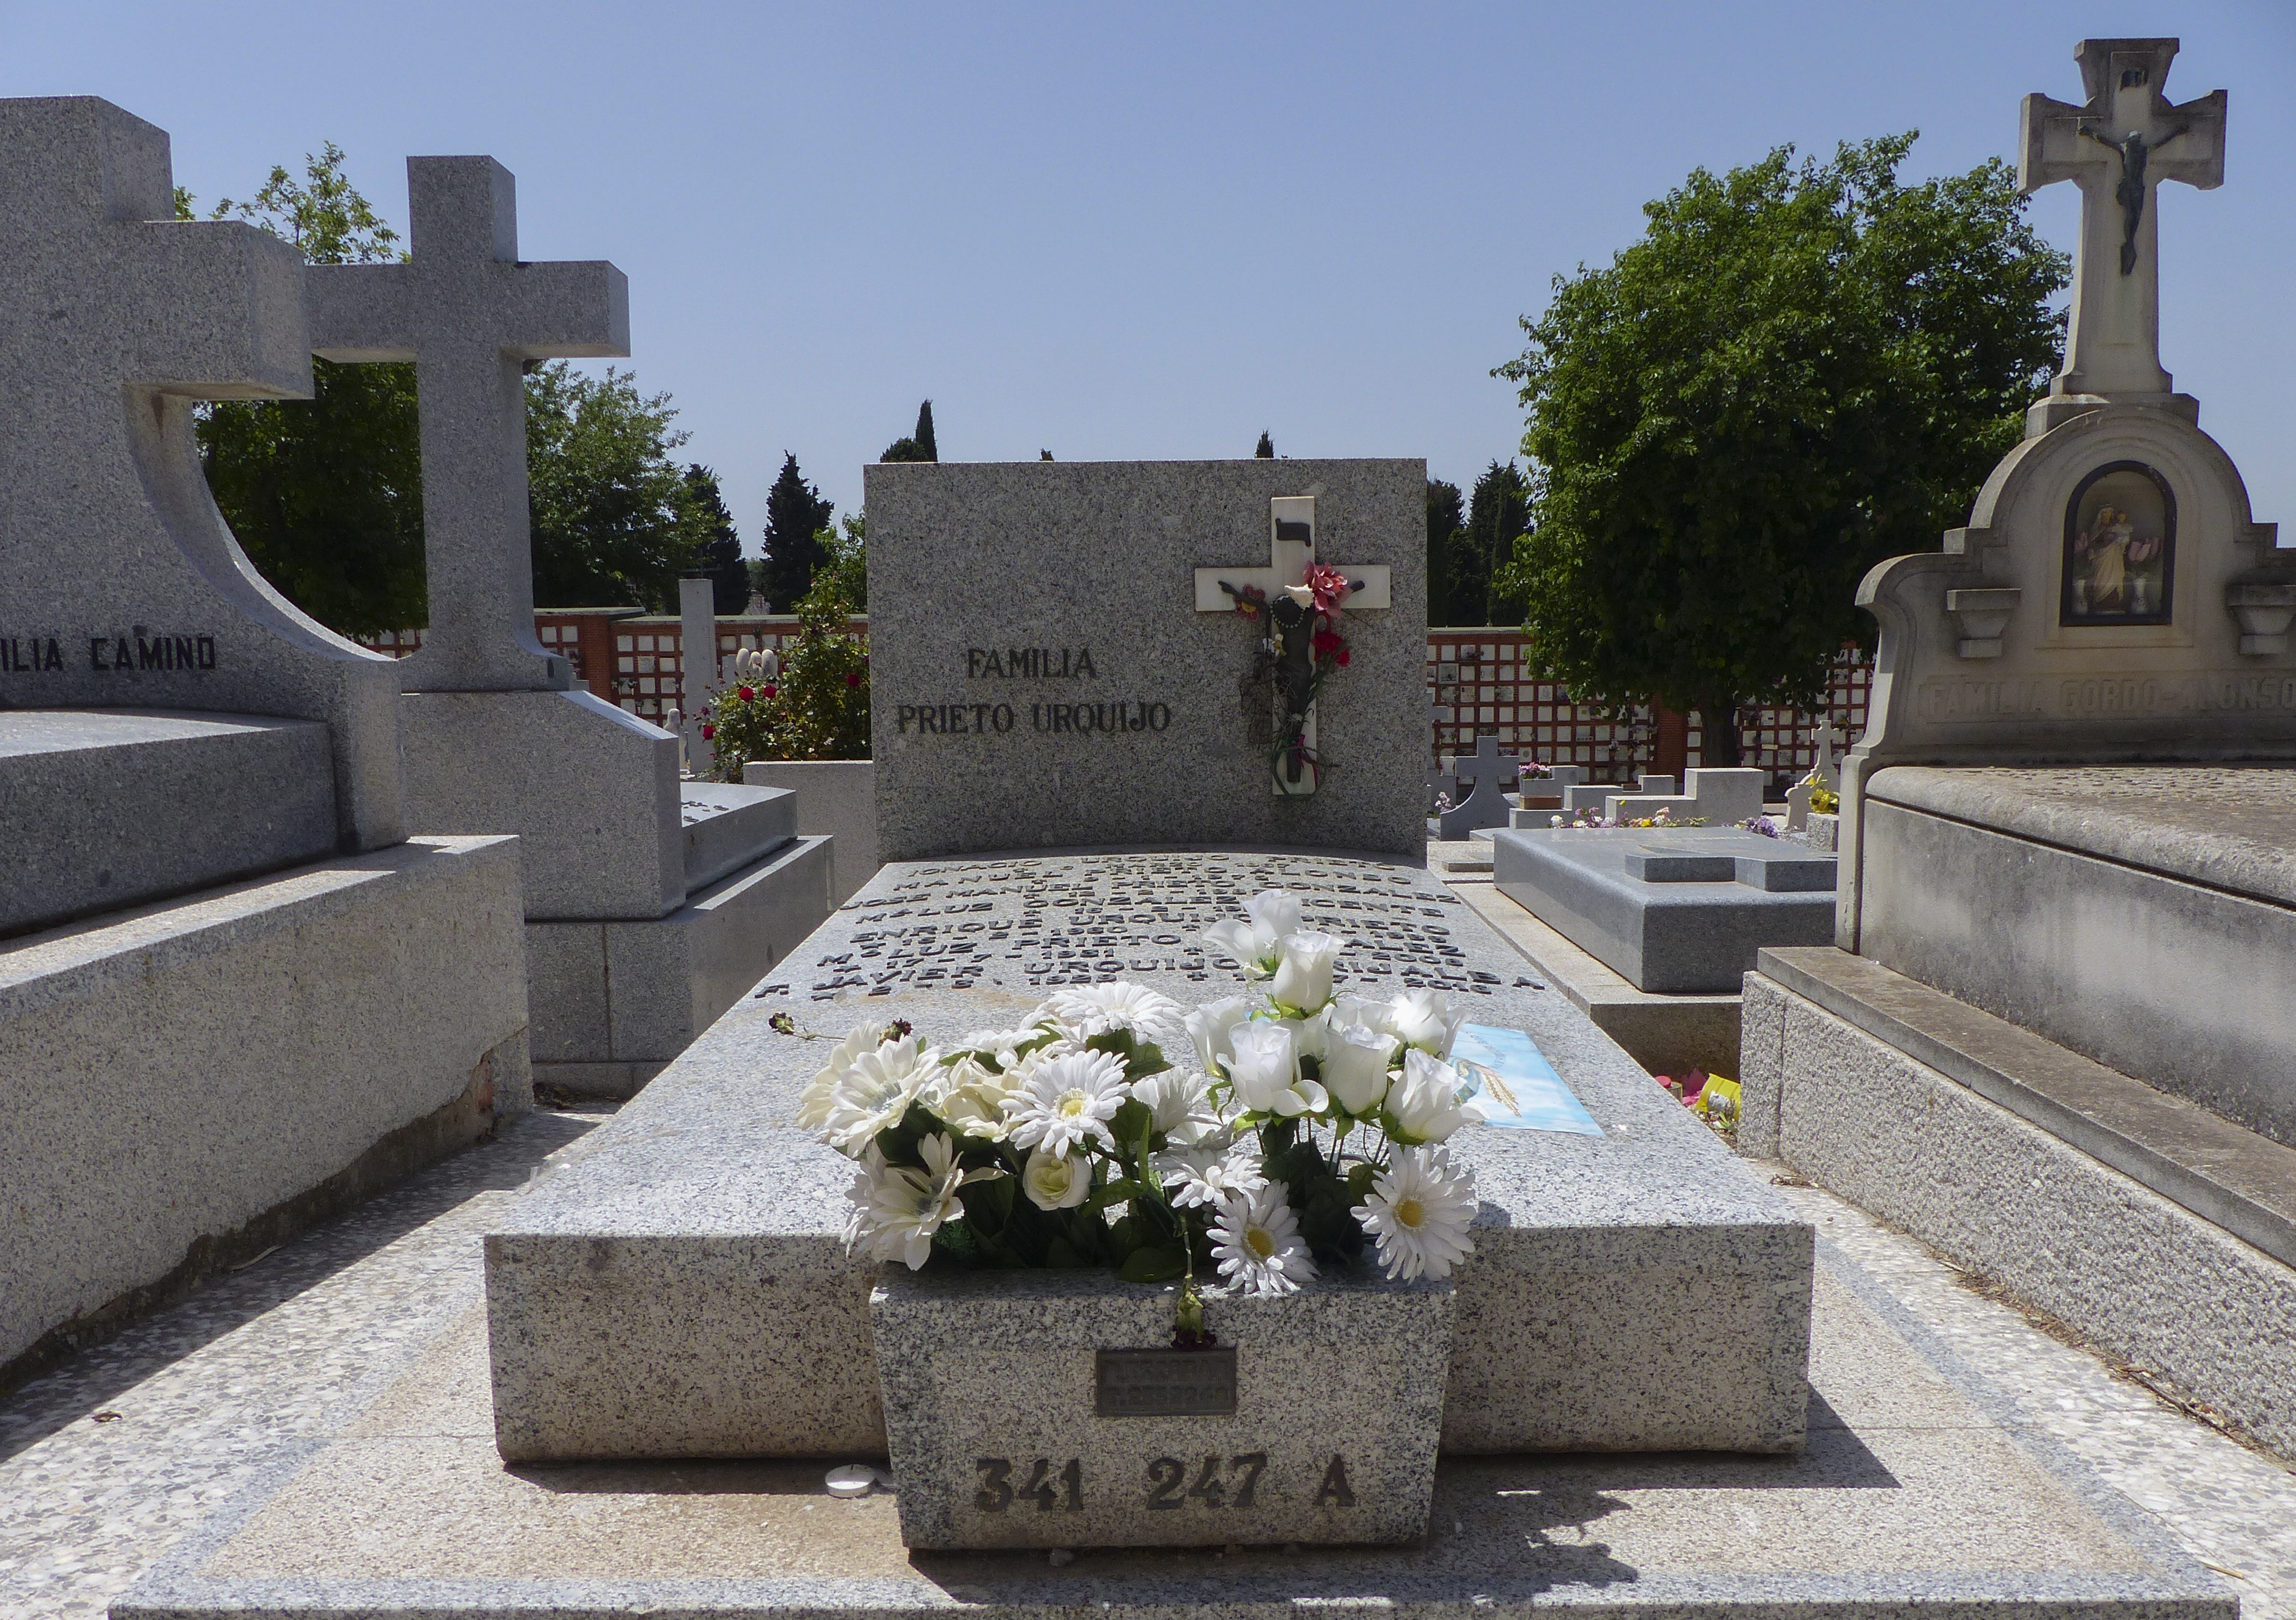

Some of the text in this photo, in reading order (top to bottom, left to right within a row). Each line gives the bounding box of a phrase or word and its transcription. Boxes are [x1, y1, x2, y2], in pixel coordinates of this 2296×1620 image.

[91, 636, 216, 671] CAMINO
[967, 648, 1096, 678] FAMILIA
[897, 702, 1171, 735] PRIETO URQUIJO
[893, 867, 1411, 891] MANUEL PRIETO ALONSO
[908, 855, 1395, 877] IGNACIO URQUIJO PRIETO
[839, 880, 1461, 910] JOSE MANUEL PRIETO GONZALEZ
[917, 902, 993, 916] LUZ
[1023, 896, 1240, 908] GONZALEZ
[1301, 898, 1444, 917] ICENTE
[850, 918, 1043, 943] ENRIQUE
[1069, 912, 1252, 926] URQUIJO
[903, 936, 936, 946] 15
[1051, 926, 1128, 936] 1960
[887, 958, 924, 969] 17
[971, 954, 992, 962] 7
[1042, 948, 1114, 959] 1931
[888, 942, 978, 958] LUZ
[1012, 934, 1181, 950] PRIETO
[1344, 938, 1466, 958] ALEZ
[755, 958, 1545, 999] F. JAVIER URQUIJO IJALBA
[868, 986, 892, 996] 2
[951, 979, 974, 989] 3
[1029, 973, 1117, 985] 1929
[976, 1451, 1356, 1512] 341 247 A
